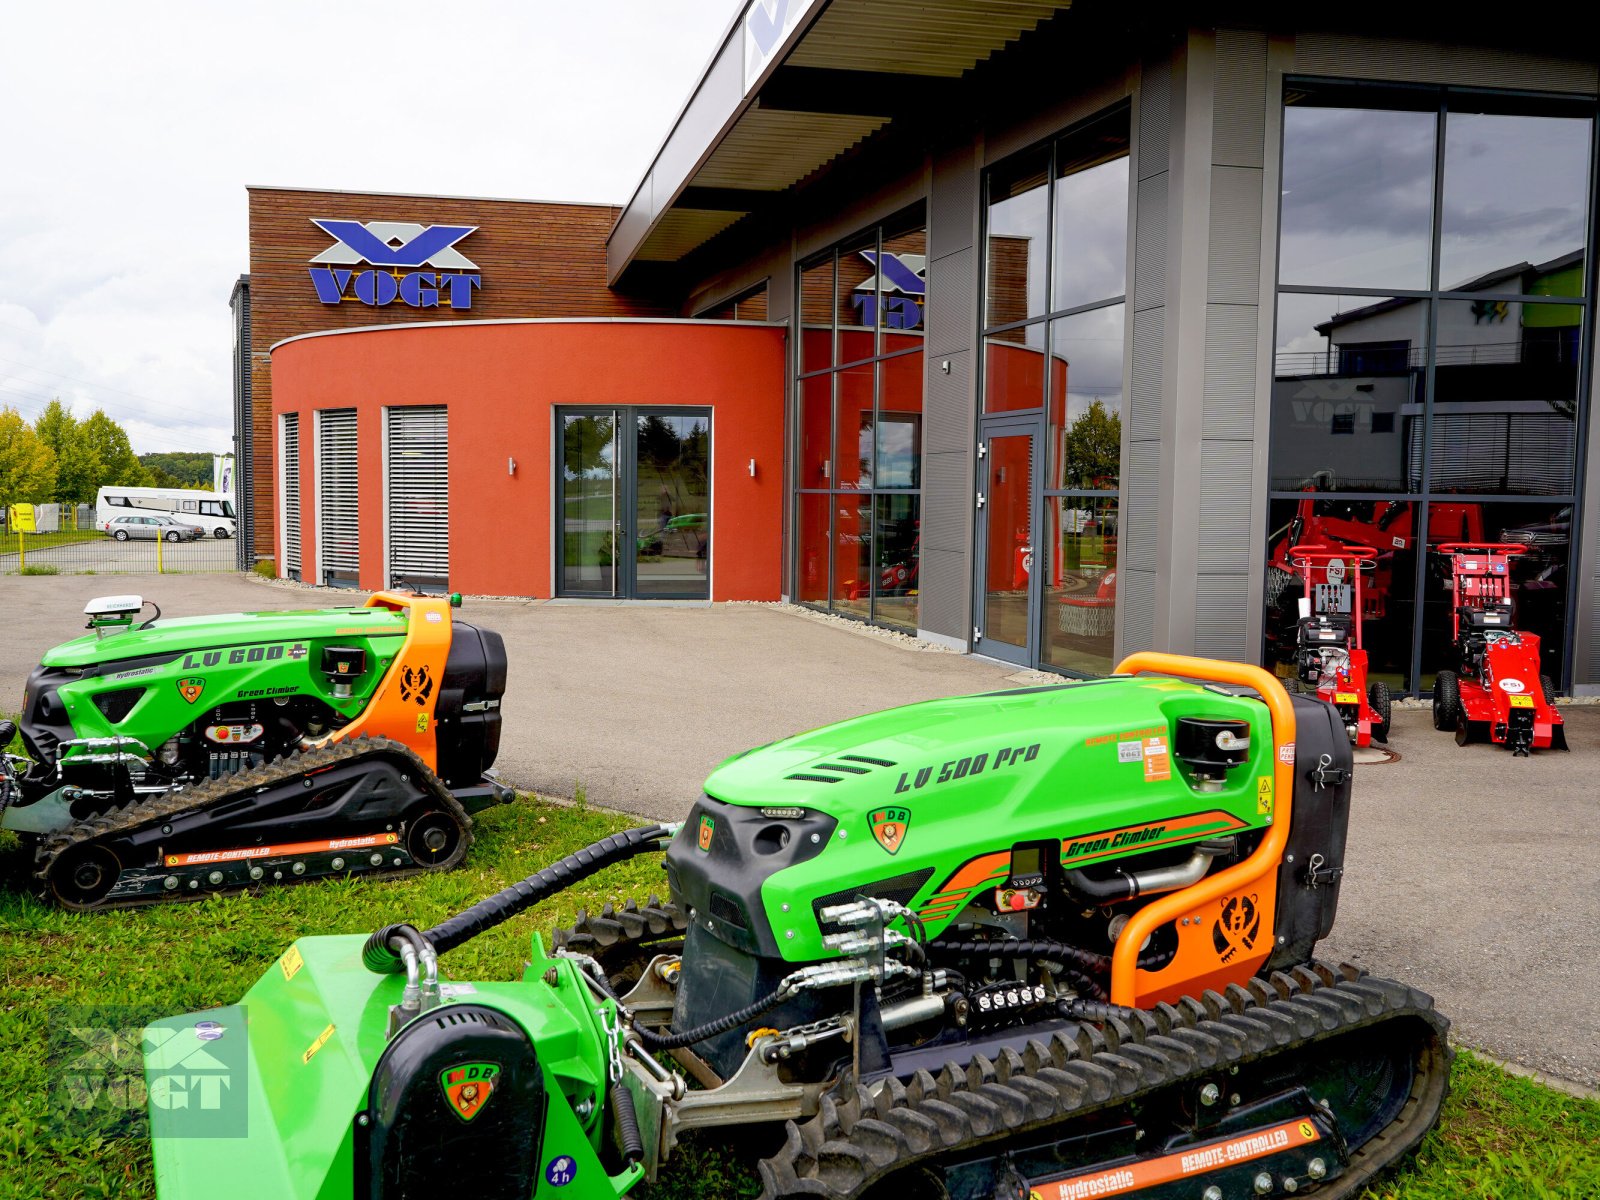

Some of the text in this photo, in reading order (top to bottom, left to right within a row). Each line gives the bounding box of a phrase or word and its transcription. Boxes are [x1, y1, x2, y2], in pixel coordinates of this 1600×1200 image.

[308, 267, 481, 309] VOGT
[228, 645, 284, 665] 600
[237, 685, 300, 698] Green Climber
[936, 753, 989, 784] 500
[992, 743, 1042, 771] Pro
[872, 810, 906, 824] MDB
[329, 837, 377, 849] Hydrostatic
[1065, 826, 1166, 857] Green Climber
[186, 847, 270, 863] REMOTE-CONTROLLED
[446, 1067, 495, 1085] MDB
[1181, 1129, 1289, 1174] REMOTE-CONTROLLED
[551, 1172, 570, 1184] 4 h
[1059, 1170, 1135, 1200] Hydrostatic
